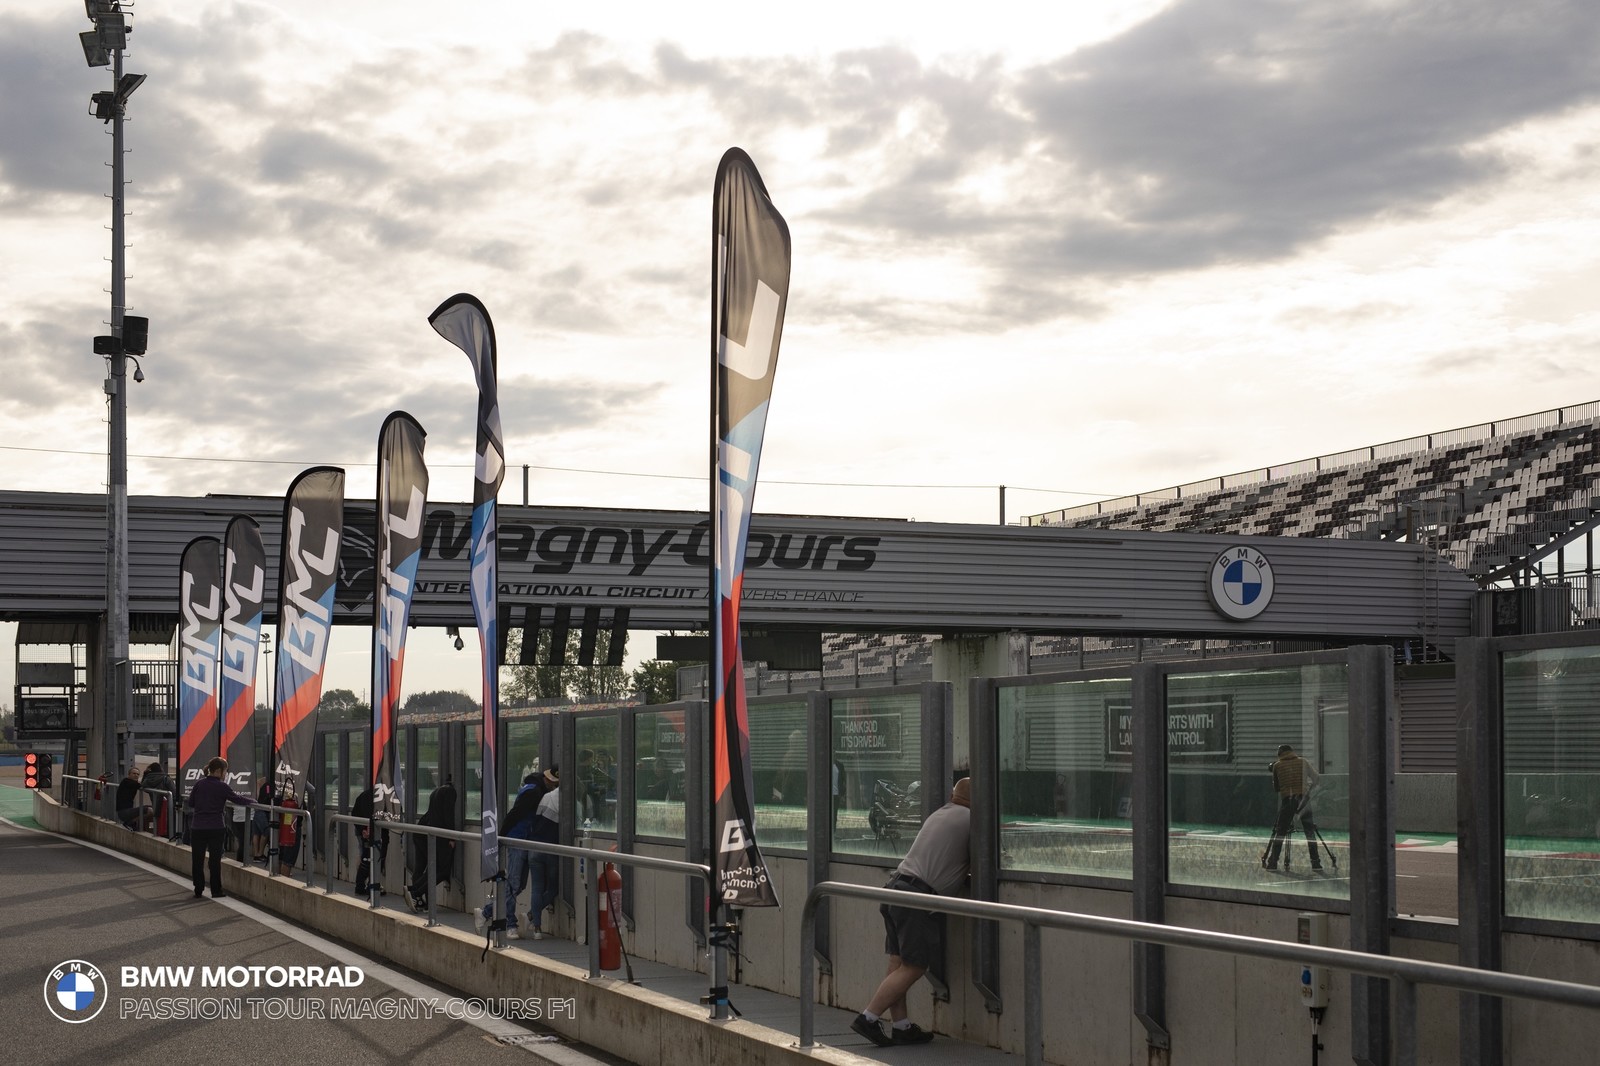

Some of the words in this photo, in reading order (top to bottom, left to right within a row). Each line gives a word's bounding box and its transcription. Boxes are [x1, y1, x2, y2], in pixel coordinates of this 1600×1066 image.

[1219, 548, 1267, 569] BMW
[283, 506, 340, 675] BMC
[606, 586, 700, 599] CIRCUIT
[794, 591, 864, 602] FRANCE
[223, 548, 264, 687] BMC
[182, 570, 220, 696] BMC
[841, 721, 863, 733] THANK
[863, 721, 878, 733] GOD
[1188, 714, 1214, 729] WITH
[854, 736, 873, 748] DRIVE
